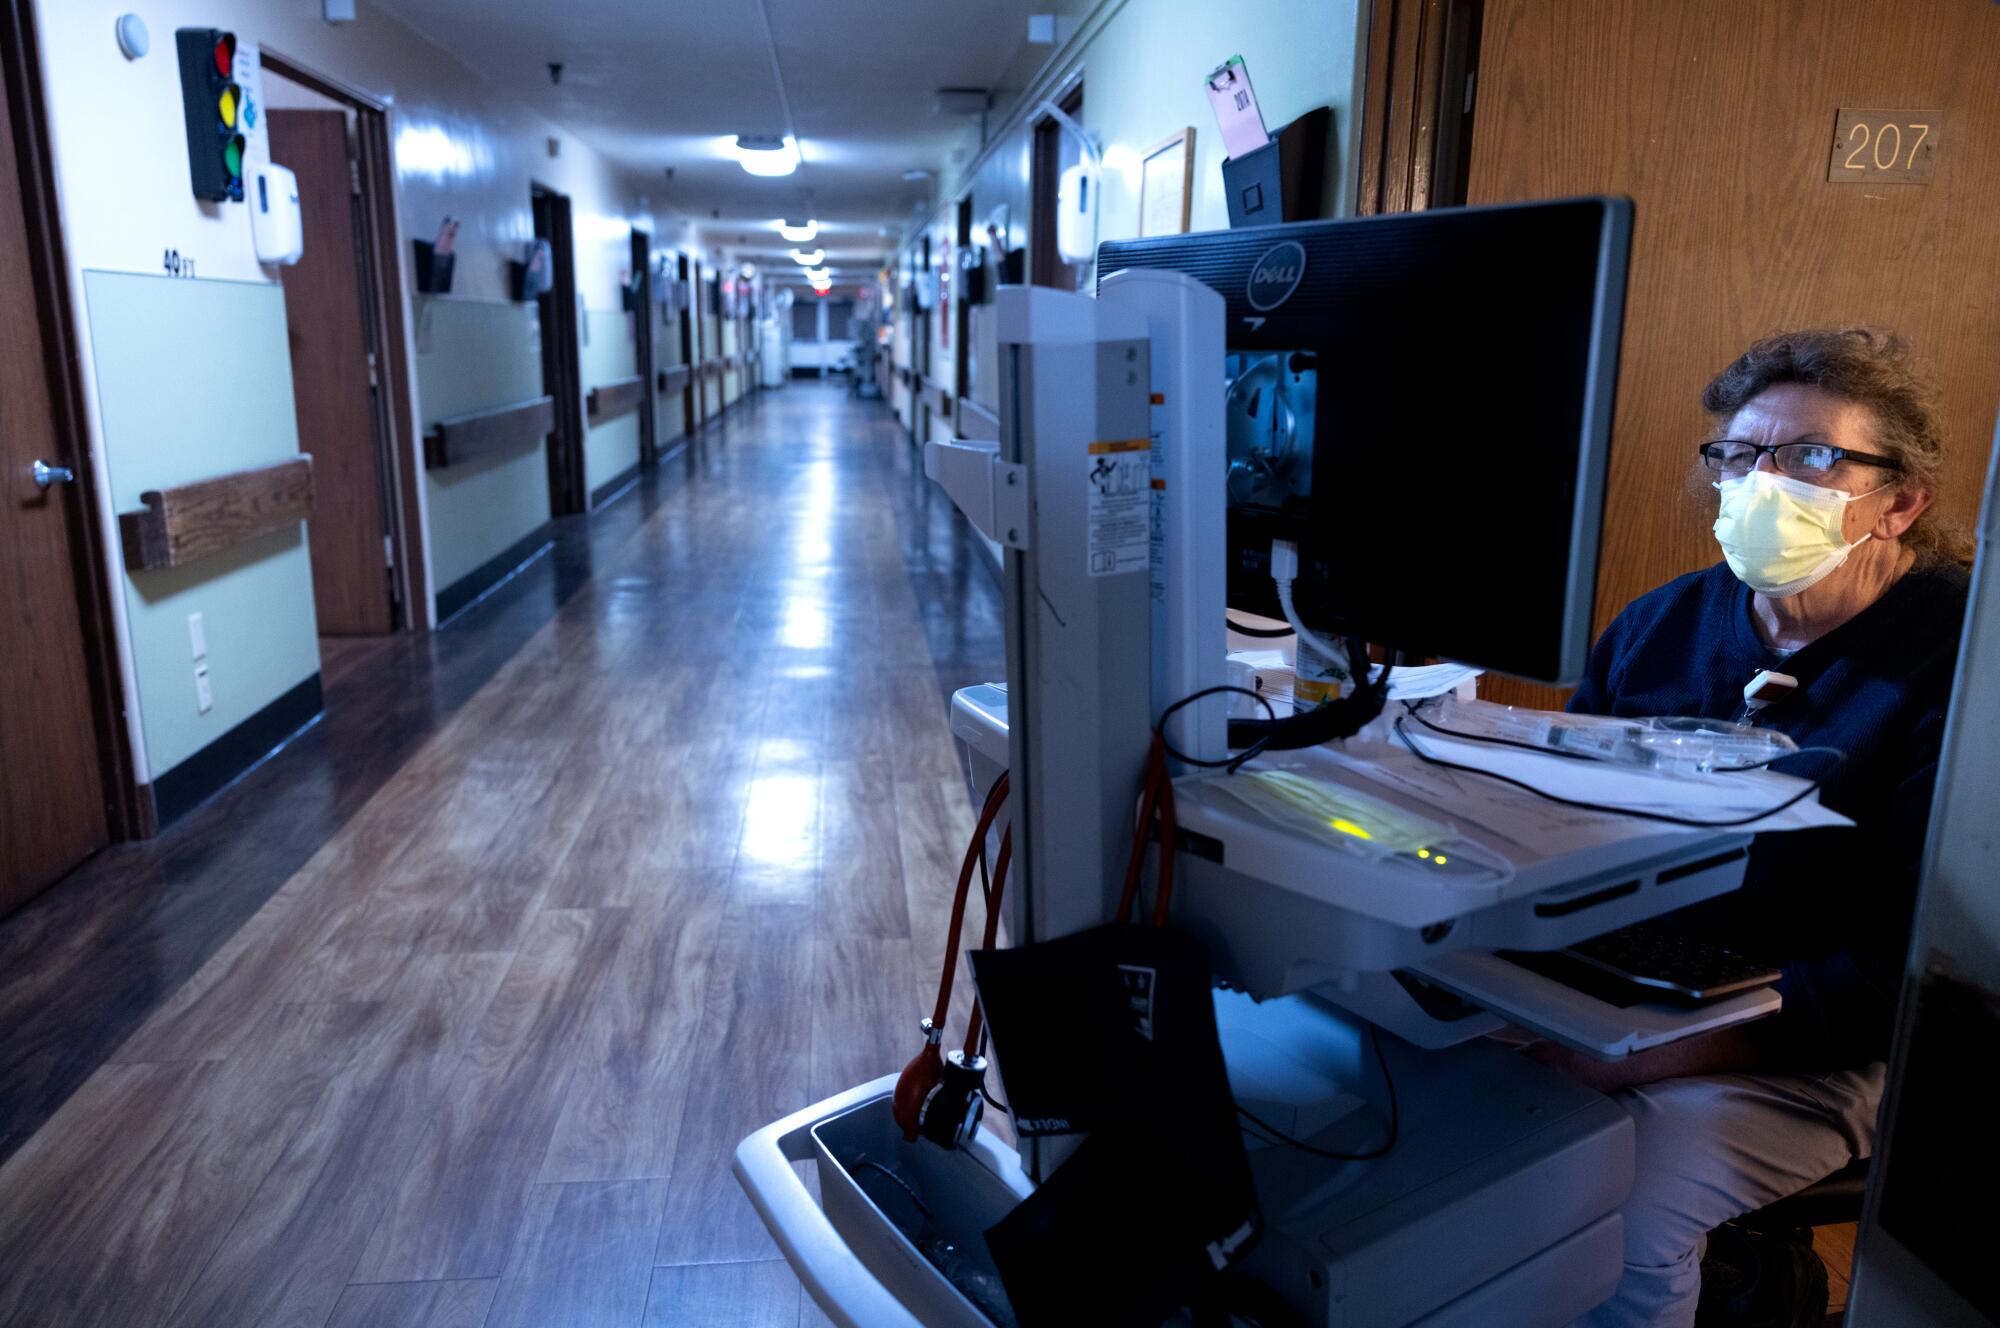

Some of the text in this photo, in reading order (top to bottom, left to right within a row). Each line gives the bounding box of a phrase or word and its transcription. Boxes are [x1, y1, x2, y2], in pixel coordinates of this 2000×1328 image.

[1844, 123, 1929, 170] 207
[164, 249, 180, 277] 40
[1255, 266, 1296, 284] DELL
